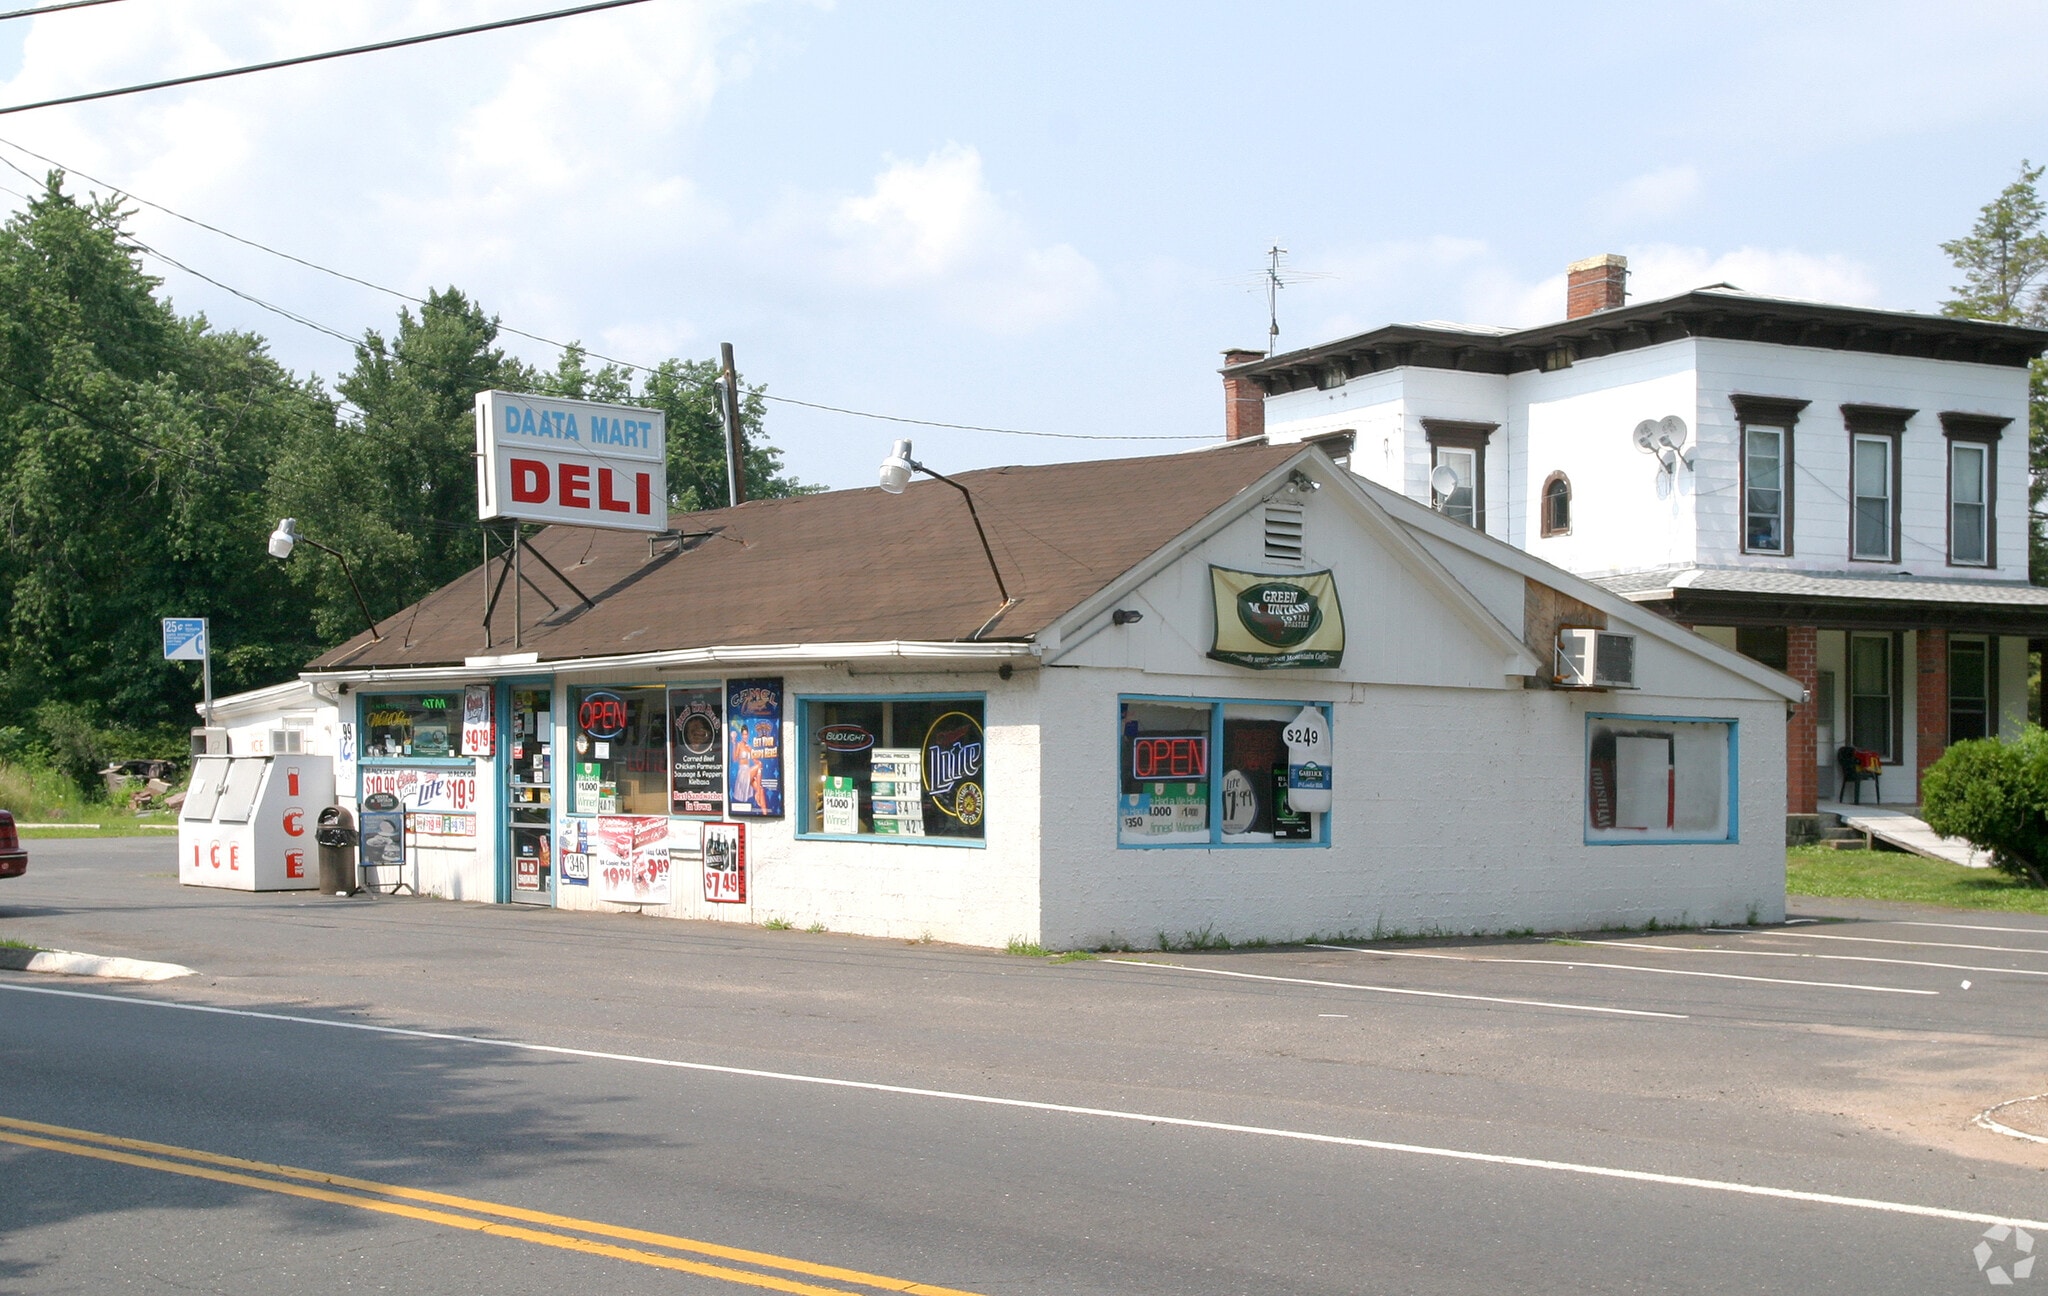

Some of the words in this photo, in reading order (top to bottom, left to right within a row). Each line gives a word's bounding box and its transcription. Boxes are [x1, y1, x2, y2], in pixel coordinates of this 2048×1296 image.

[505, 406, 580, 441] DAATA
[591, 416, 652, 449] MART
[510, 458, 651, 515] DELI
[1263, 590, 1298, 603] GREEN
[422, 699, 446, 709] ATM
[579, 701, 627, 729] OPEN
[251, 739, 264, 752] ICE
[826, 732, 843, 741] BUD
[843, 733, 866, 742] LIGHT
[928, 742, 981, 795] Lite
[1136, 739, 1206, 776] OPEN
[417, 780, 445, 807] Lite
[674, 791, 687, 800] Best
[686, 802, 693, 811] In
[694, 802, 712, 811] Town
[1591, 767, 1612, 828] Winston
[282, 767, 305, 879] ICE
[1124, 817, 1143, 828] $350
[1151, 822, 1174, 832] inner!
[193, 838, 239, 871] ICE
